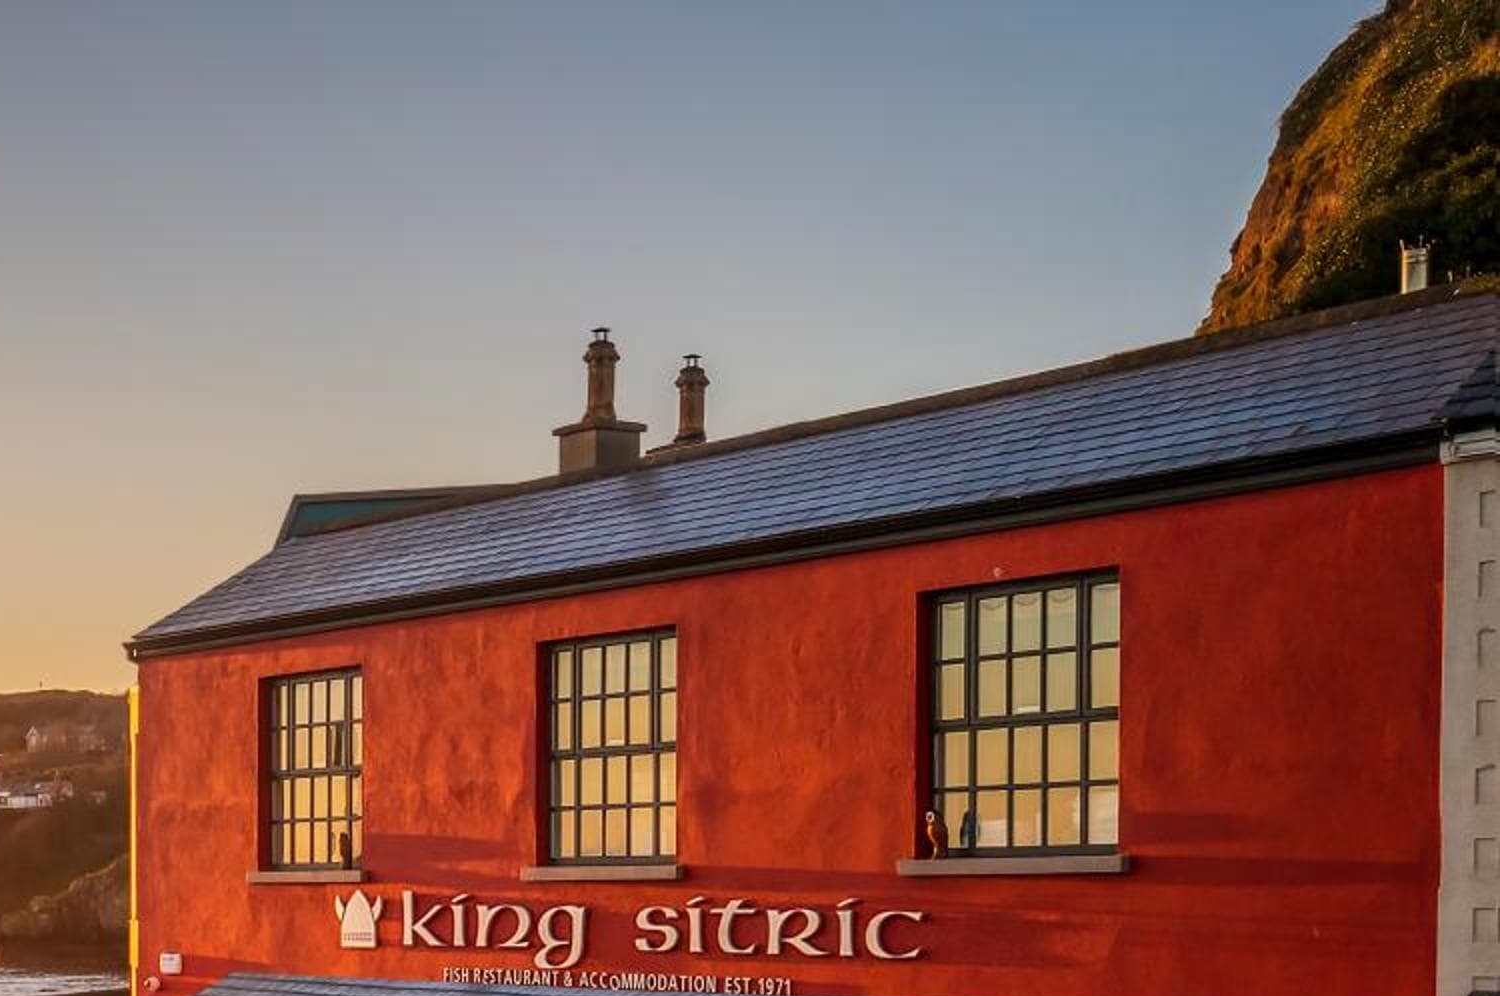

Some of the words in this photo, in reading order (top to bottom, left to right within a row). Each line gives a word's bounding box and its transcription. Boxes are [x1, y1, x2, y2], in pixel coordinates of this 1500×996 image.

[443, 968, 470, 984] FISH
[473, 968, 559, 986] RESTAURANT
[564, 971, 573, 987] &
[579, 971, 717, 992] ACCOMMODATION
